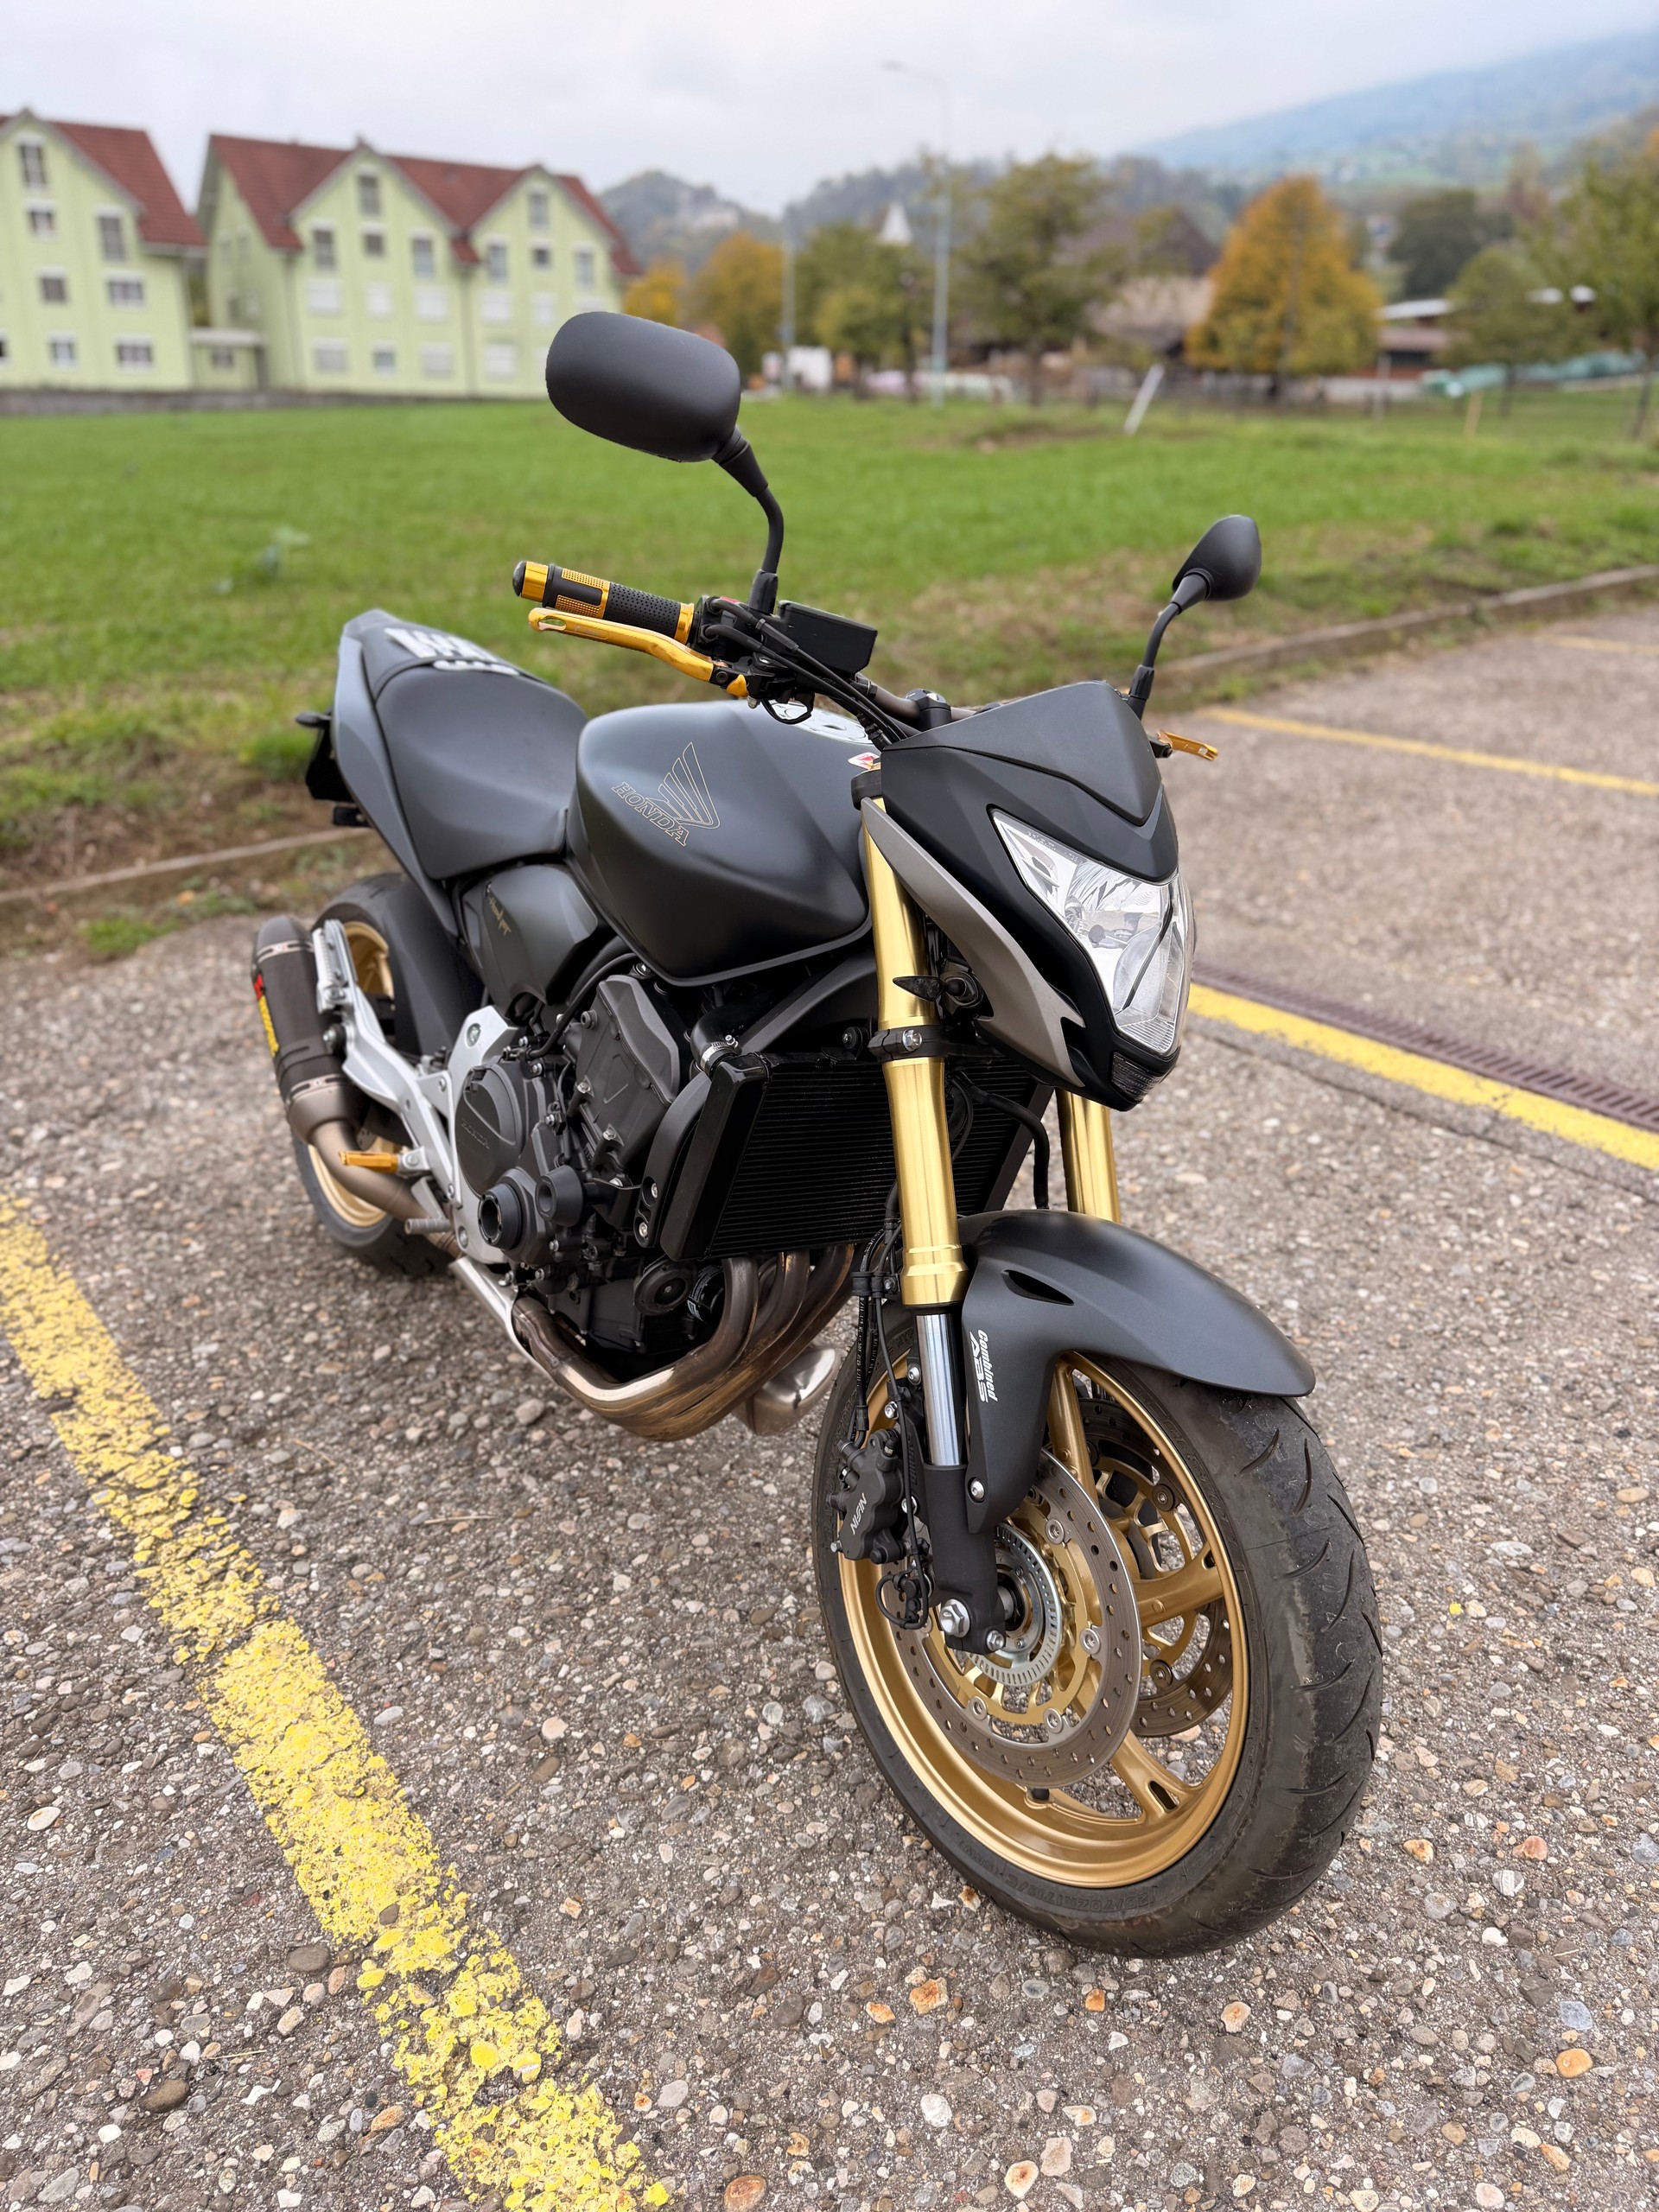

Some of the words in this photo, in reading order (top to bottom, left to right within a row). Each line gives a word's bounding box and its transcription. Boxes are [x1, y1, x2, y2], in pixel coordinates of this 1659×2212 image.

[611, 781, 690, 847] HONDA
[969, 1332, 988, 1403] ABS
[978, 1329, 998, 1402] Combined
